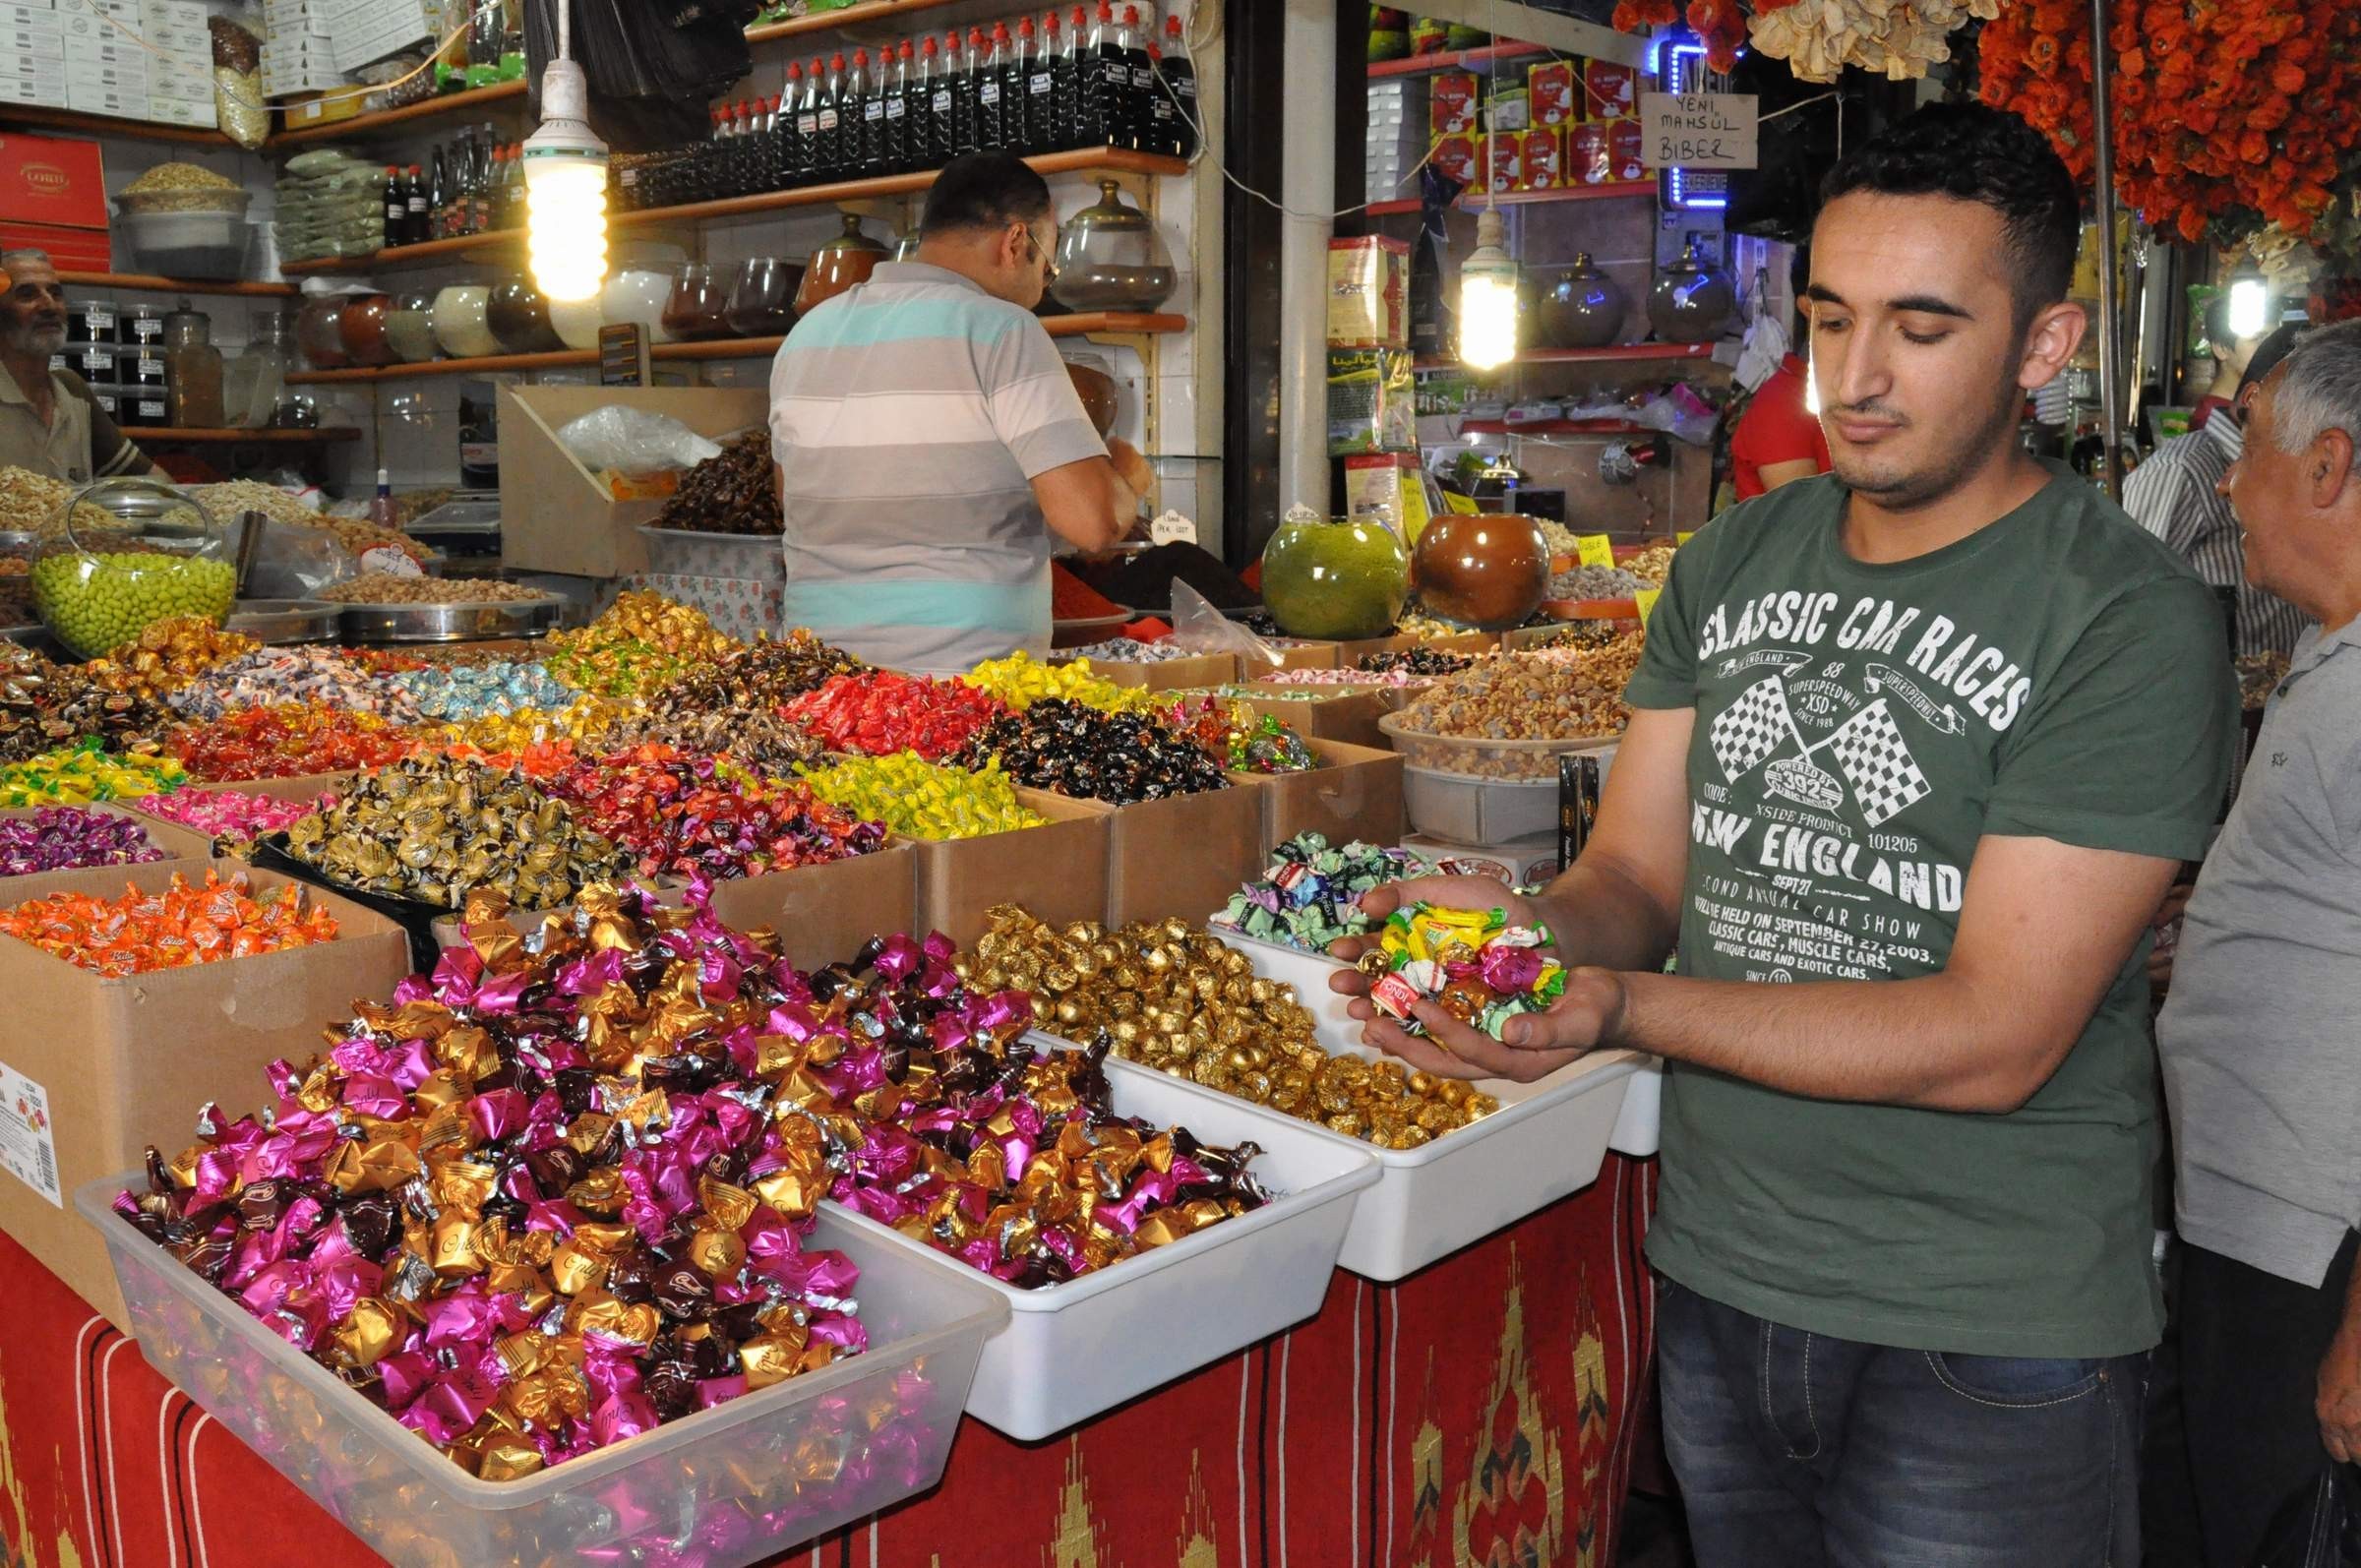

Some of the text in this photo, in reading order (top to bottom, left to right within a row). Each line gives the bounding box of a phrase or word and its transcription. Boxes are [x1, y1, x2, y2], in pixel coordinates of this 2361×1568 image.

[1698, 590, 2032, 733] CLASSIC CAR RACES
[1822, 661, 1846, 679] 88
[1788, 678, 1861, 711] SUPERSPEEDWAY
[1806, 693, 1830, 715] XSD
[1884, 669, 1937, 722] SUPERSPEEDWAY
[1794, 707, 1834, 729] SINCE 1988
[1771, 780, 1801, 802] CUBIC
[1776, 761, 1835, 788] POWERED BY
[1783, 770, 1822, 800] 392
[1754, 804, 1853, 839] XSIDE PRODUCT
[1868, 834, 1918, 854] 101205
[1759, 823, 1963, 913] ENGLAND
[1721, 906, 1751, 926] HELD
[1753, 913, 1772, 929] ON
[1775, 917, 1854, 946] SEPTEMBER
[1813, 904, 1848, 927] CAR
[1862, 913, 1921, 940] SHOW
[1708, 921, 1744, 942] CLASSIC
[1786, 936, 1842, 962] MUSCLE
[1713, 940, 1747, 958] ANTIQUE
[1748, 947, 1773, 962] CARS
[1774, 953, 1796, 967] AND
[1796, 959, 1834, 975] EXOTIC
[563, 1252, 602, 1282] Only
